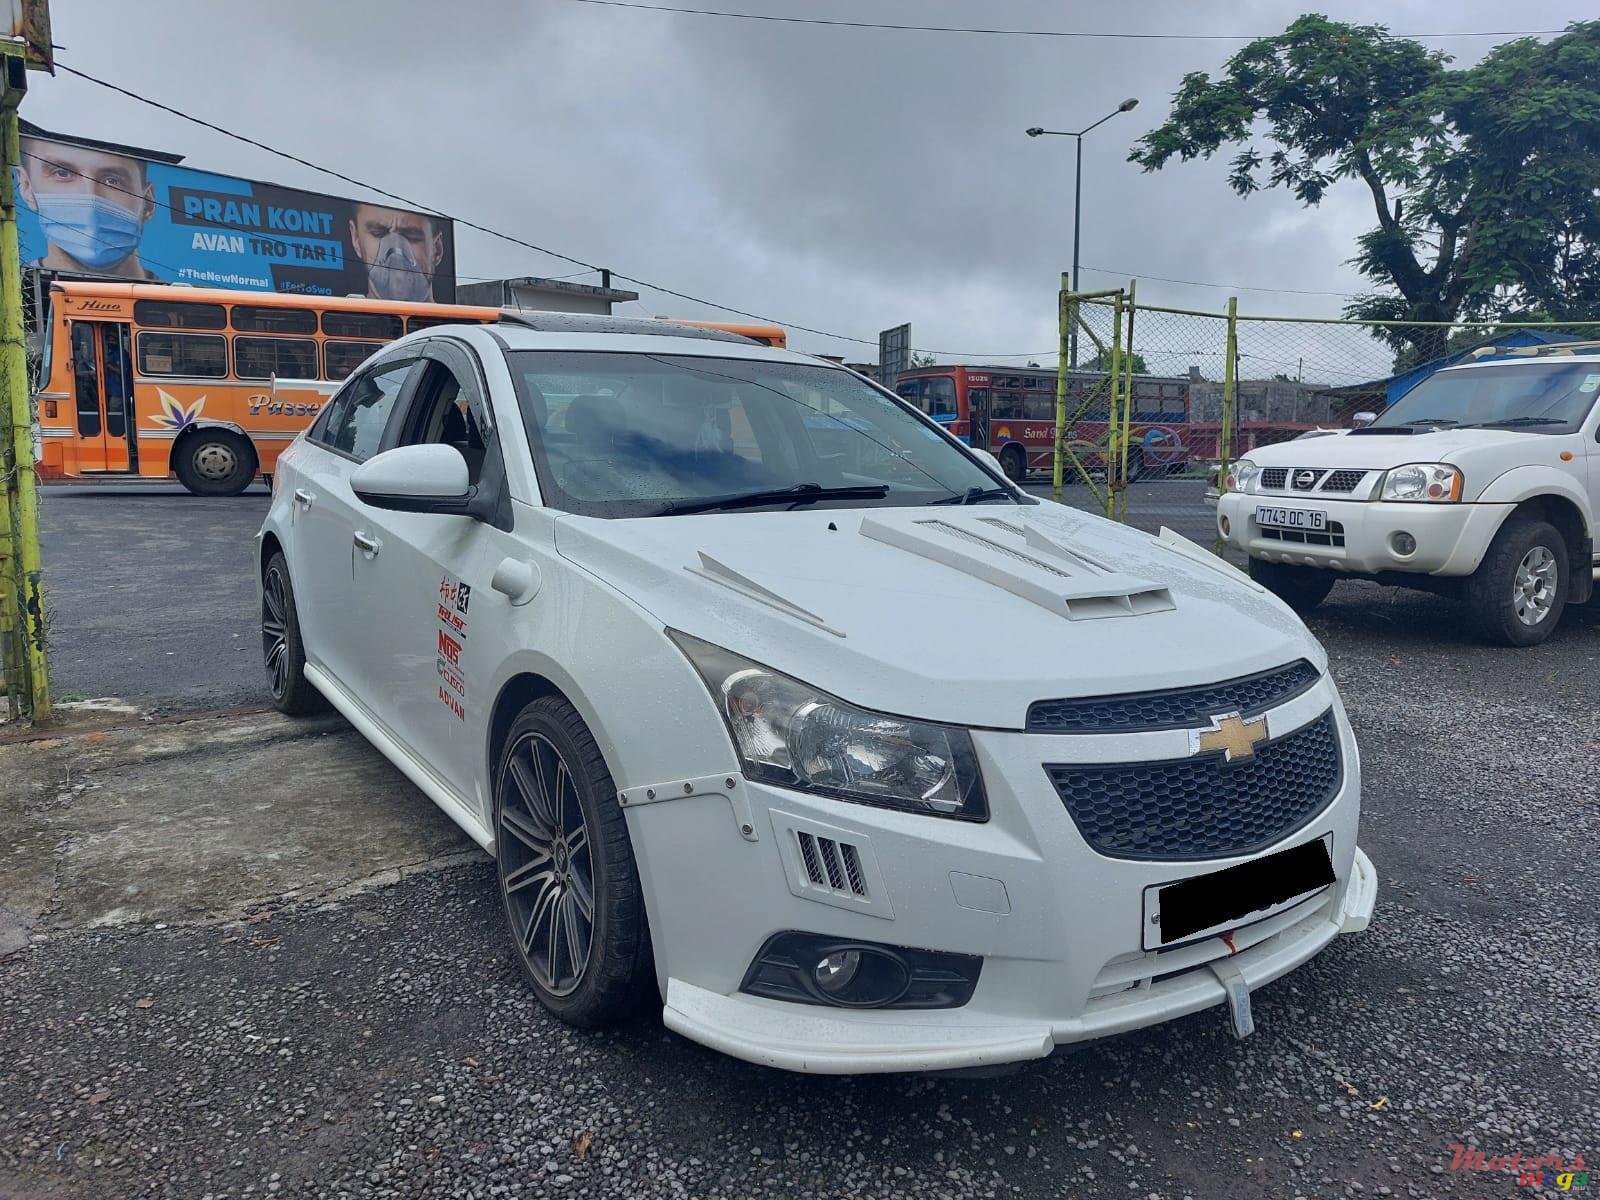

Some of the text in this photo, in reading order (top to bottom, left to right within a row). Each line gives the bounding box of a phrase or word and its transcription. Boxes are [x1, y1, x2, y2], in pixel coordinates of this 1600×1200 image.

[183, 195, 333, 235] PRAN KONT
[192, 232, 245, 254] AVAN
[249, 238, 288, 258] TRO
[292, 242, 327, 262] TAR
[178, 267, 269, 288] #TheNewNormal
[77, 300, 121, 311] Hino
[1023, 427, 1048, 439] Sand
[1260, 508, 1322, 528] 7743 OC 16
[439, 629, 462, 666] NOS
[438, 686, 465, 721] ADVAN
